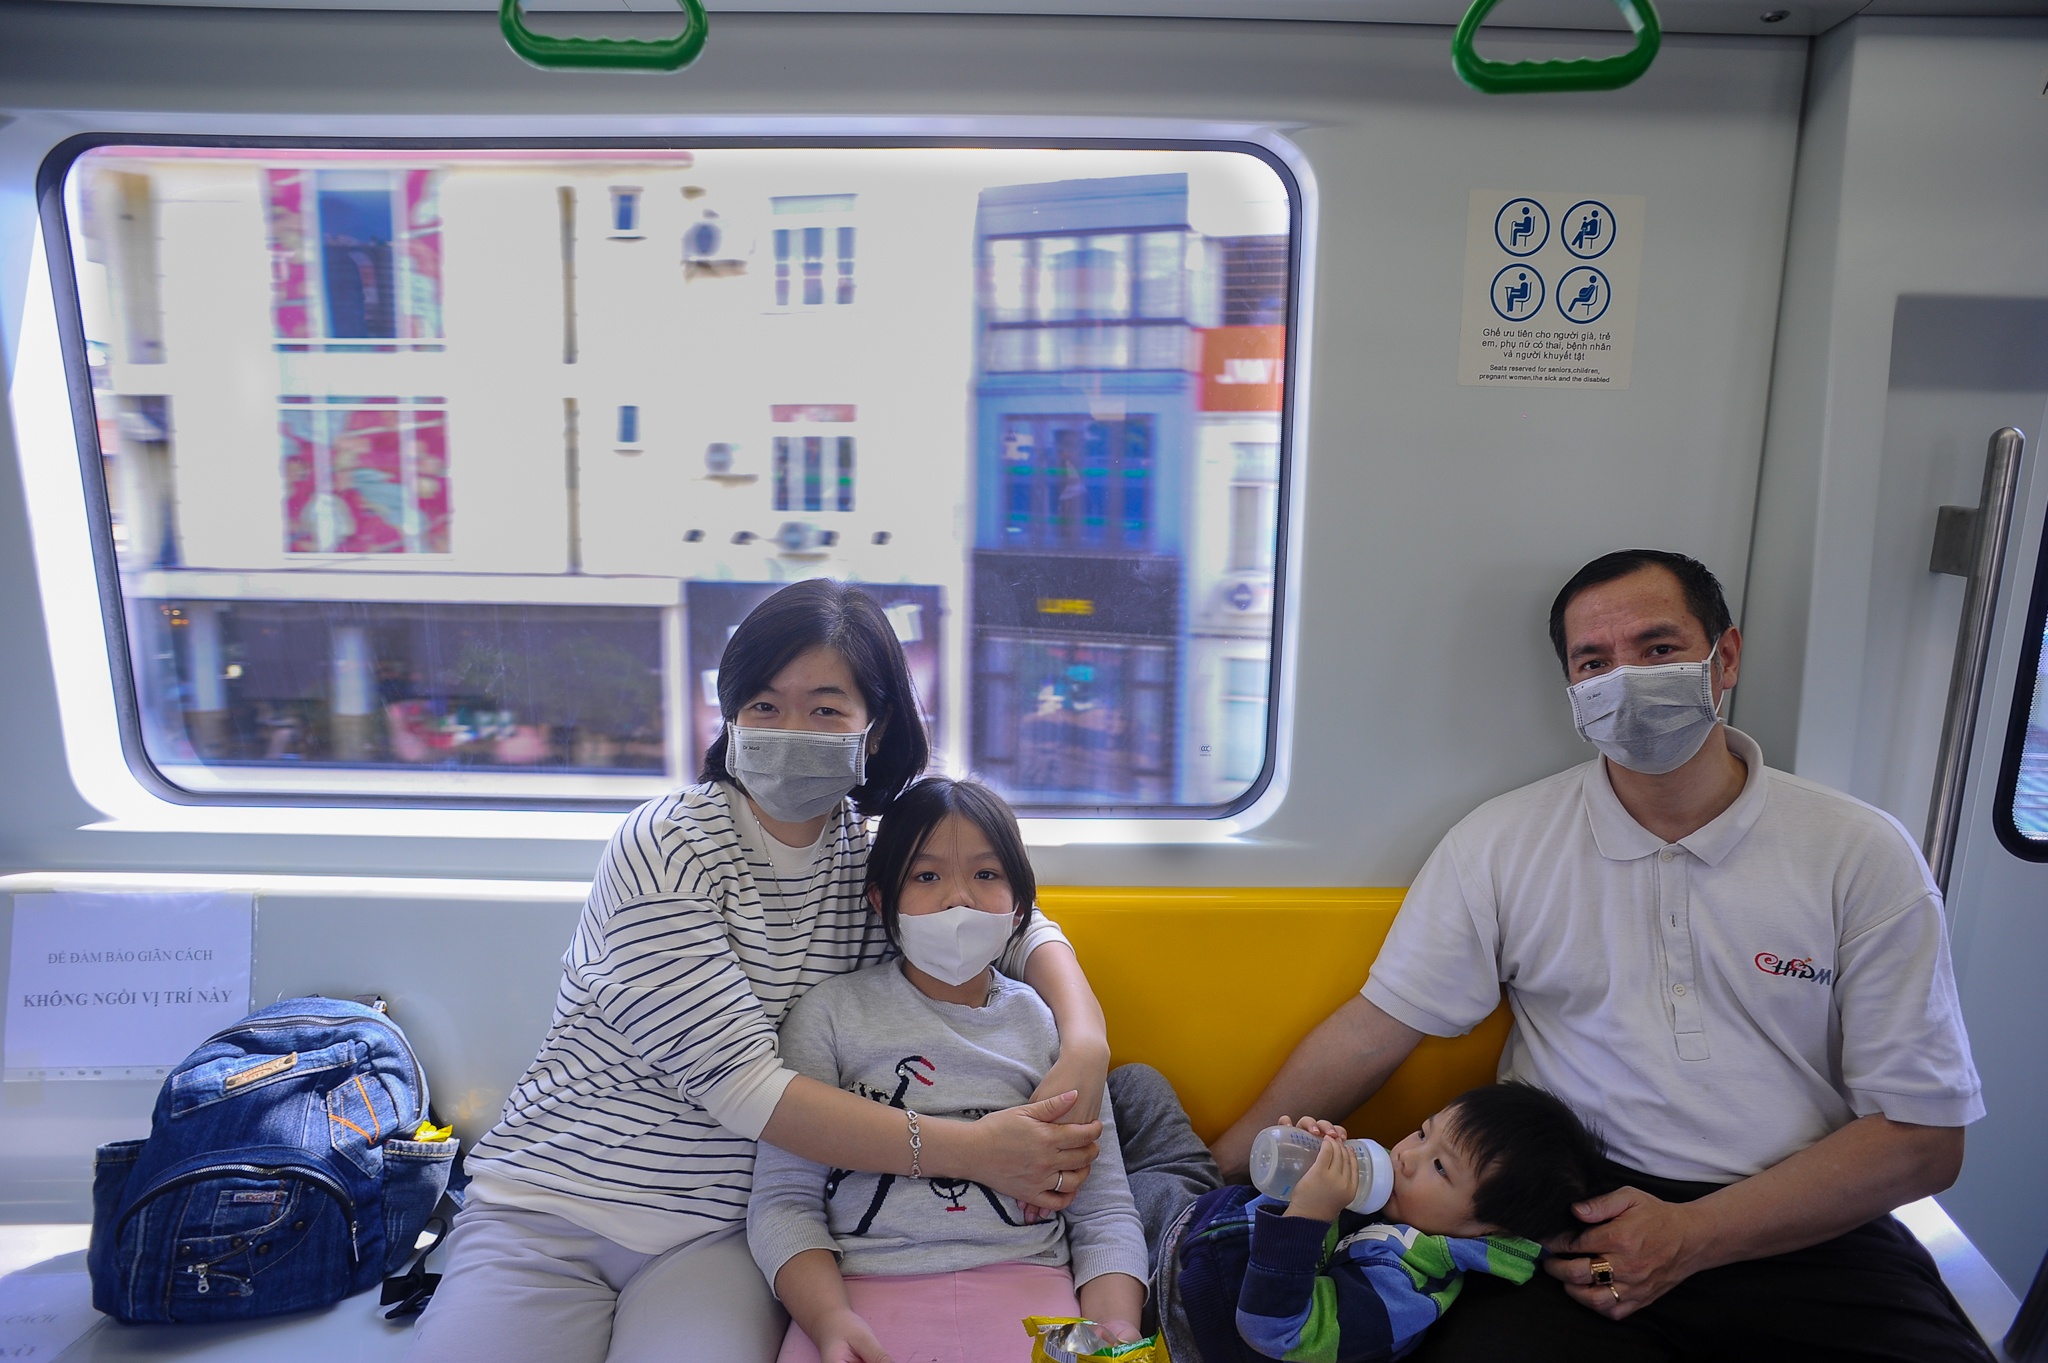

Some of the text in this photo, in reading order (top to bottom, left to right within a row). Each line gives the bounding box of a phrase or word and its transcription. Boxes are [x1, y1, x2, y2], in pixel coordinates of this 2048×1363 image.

[1482, 327, 1611, 342] Ghế ưu tiên cho người già, trẻ
[1500, 340, 1516, 350] phụ
[1533, 340, 1543, 349] có
[1545, 341, 1564, 350] thai,
[1566, 341, 1588, 351] bệnh
[1590, 342, 1611, 351] nhân
[1515, 351, 1541, 360] người
[1543, 350, 1572, 361] khuyết
[1574, 352, 1585, 361] tật
[1489, 364, 1507, 372] Seats
[1479, 374, 1508, 382] pregnant
[137, 947, 172, 963] GIÃN
[175, 946, 213, 961] CÁCH
[23, 989, 88, 1008] KHÔNG
[143, 991, 160, 1007] VỊ
[163, 987, 193, 1004] TRÍ
[197, 986, 232, 1003] NÀY
